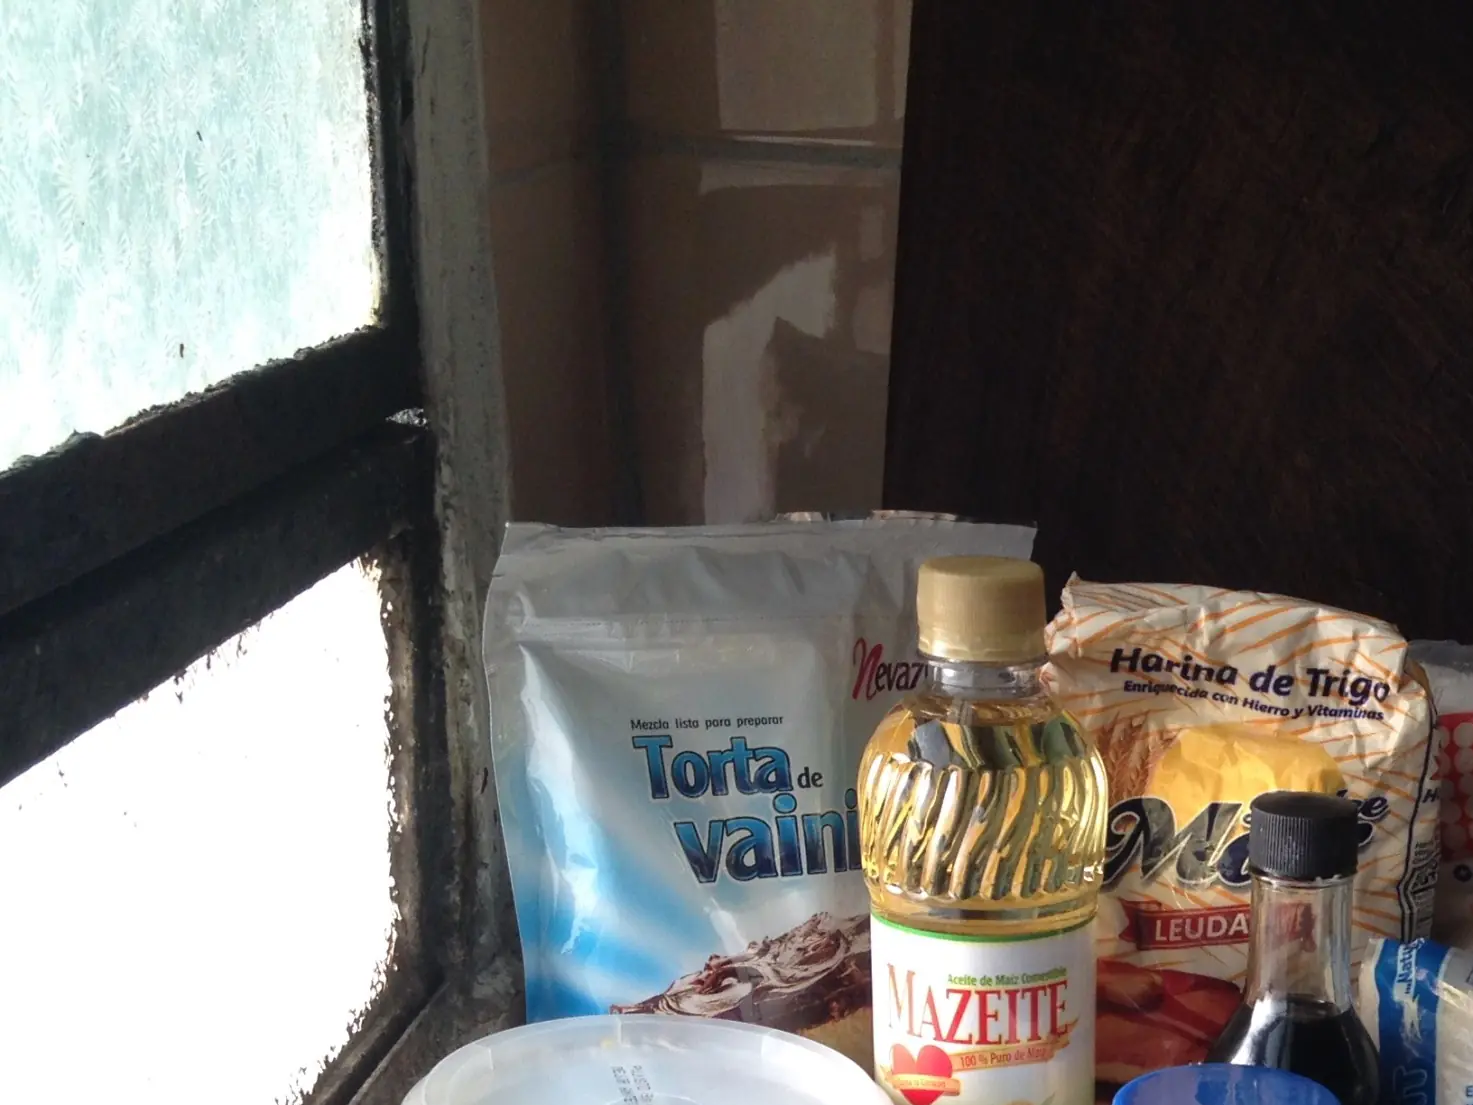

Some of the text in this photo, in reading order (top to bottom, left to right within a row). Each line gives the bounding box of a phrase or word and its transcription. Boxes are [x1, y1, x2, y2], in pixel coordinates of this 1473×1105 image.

[1109, 648, 1391, 706] Harina de Trigo
[1123, 680, 1385, 720] Enriquecida con Hierro y Vitaminas
[630, 714, 784, 731] Mezcla lista para preparar
[631, 734, 824, 800] Torta de
[947, 973, 977, 986] Aceite
[979, 974, 993, 987] de
[887, 962, 1070, 1047] MAZEITE
[960, 1055, 977, 1069] 100
[990, 1051, 1012, 1066] Puro
[1014, 1049, 1025, 1061] de
